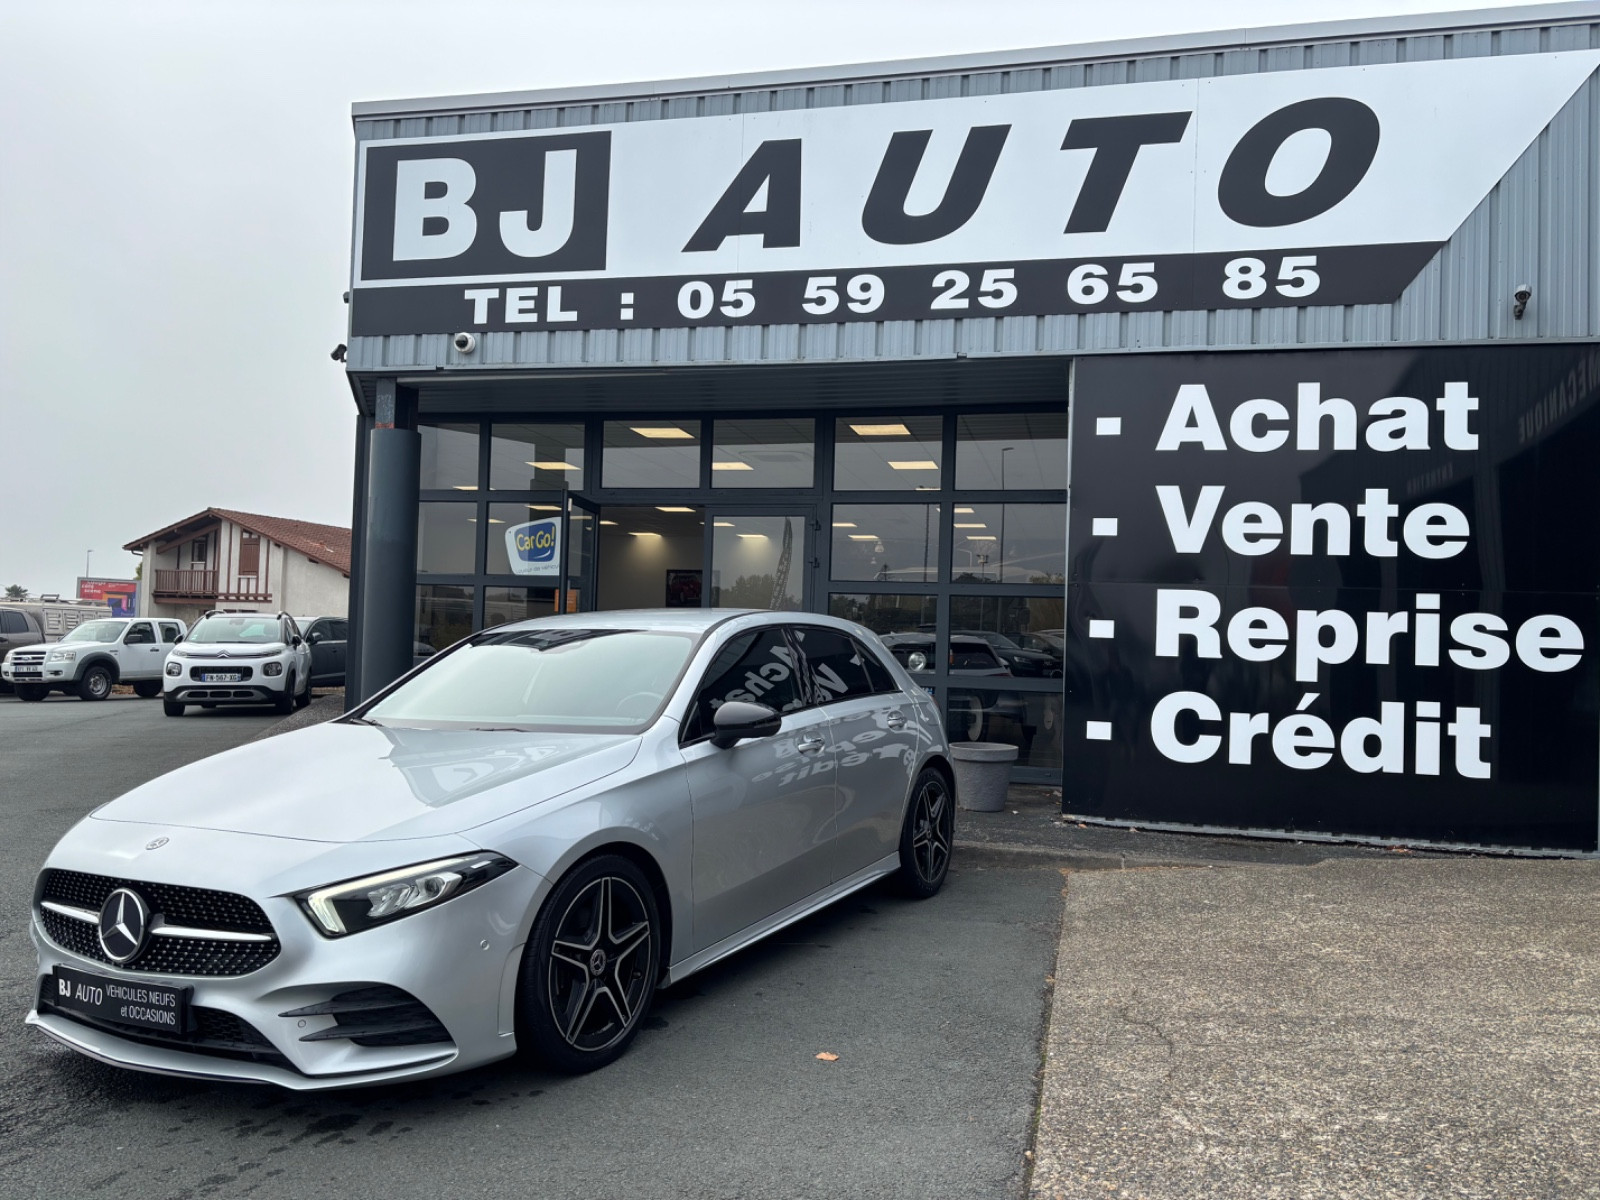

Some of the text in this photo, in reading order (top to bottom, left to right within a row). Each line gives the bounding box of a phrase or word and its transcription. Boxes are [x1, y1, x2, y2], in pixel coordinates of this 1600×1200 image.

[393, 97, 1380, 262] BJ AUTO
[464, 286, 579, 325] TEL
[677, 280, 756, 320] 05
[802, 274, 885, 315] 59
[930, 269, 1018, 310] 25
[1067, 263, 1158, 305] 65
[1222, 256, 1321, 300] 85
[1156, 382, 1479, 453] Achat
[1156, 486, 1470, 559] Vente
[1155, 589, 1584, 683] Reprise
[1151, 692, 1491, 779] Crédit
[58, 979, 103, 1005] BJ AUTO
[120, 1005, 176, 1026] et OCCASIONS
[148, 991, 176, 1007] NEUFS
